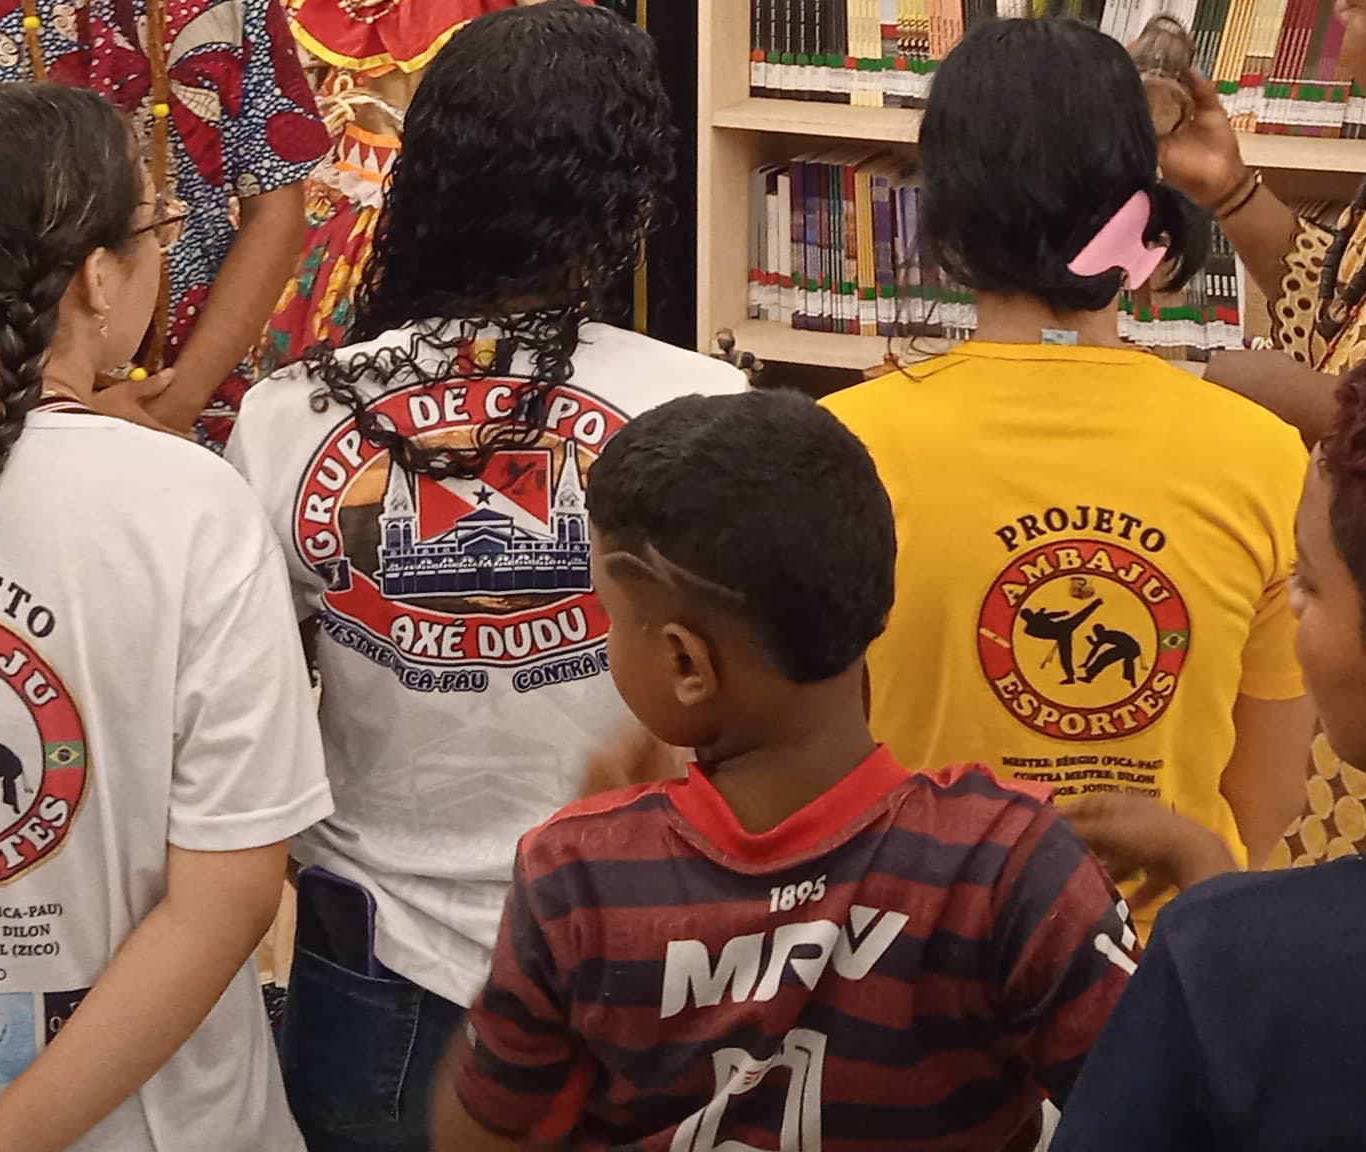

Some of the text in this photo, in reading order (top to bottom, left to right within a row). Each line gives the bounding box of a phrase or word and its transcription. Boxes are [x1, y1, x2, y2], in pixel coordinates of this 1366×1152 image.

[409, 387, 471, 429] DE
[484, 385, 606, 446] CPO
[995, 505, 1167, 553] PROJETO
[1000, 547, 1171, 607] AMBAJU
[391, 607, 588, 659] AXÉ DUDU
[514, 653, 598, 691] CONTRA
[994, 671, 1177, 736] ESPORTES
[769, 874, 827, 913] 1895
[2, 923, 51, 938] DILON
[11, 941, 60, 957] (ZICO)
[660, 904, 910, 1019] MRV
